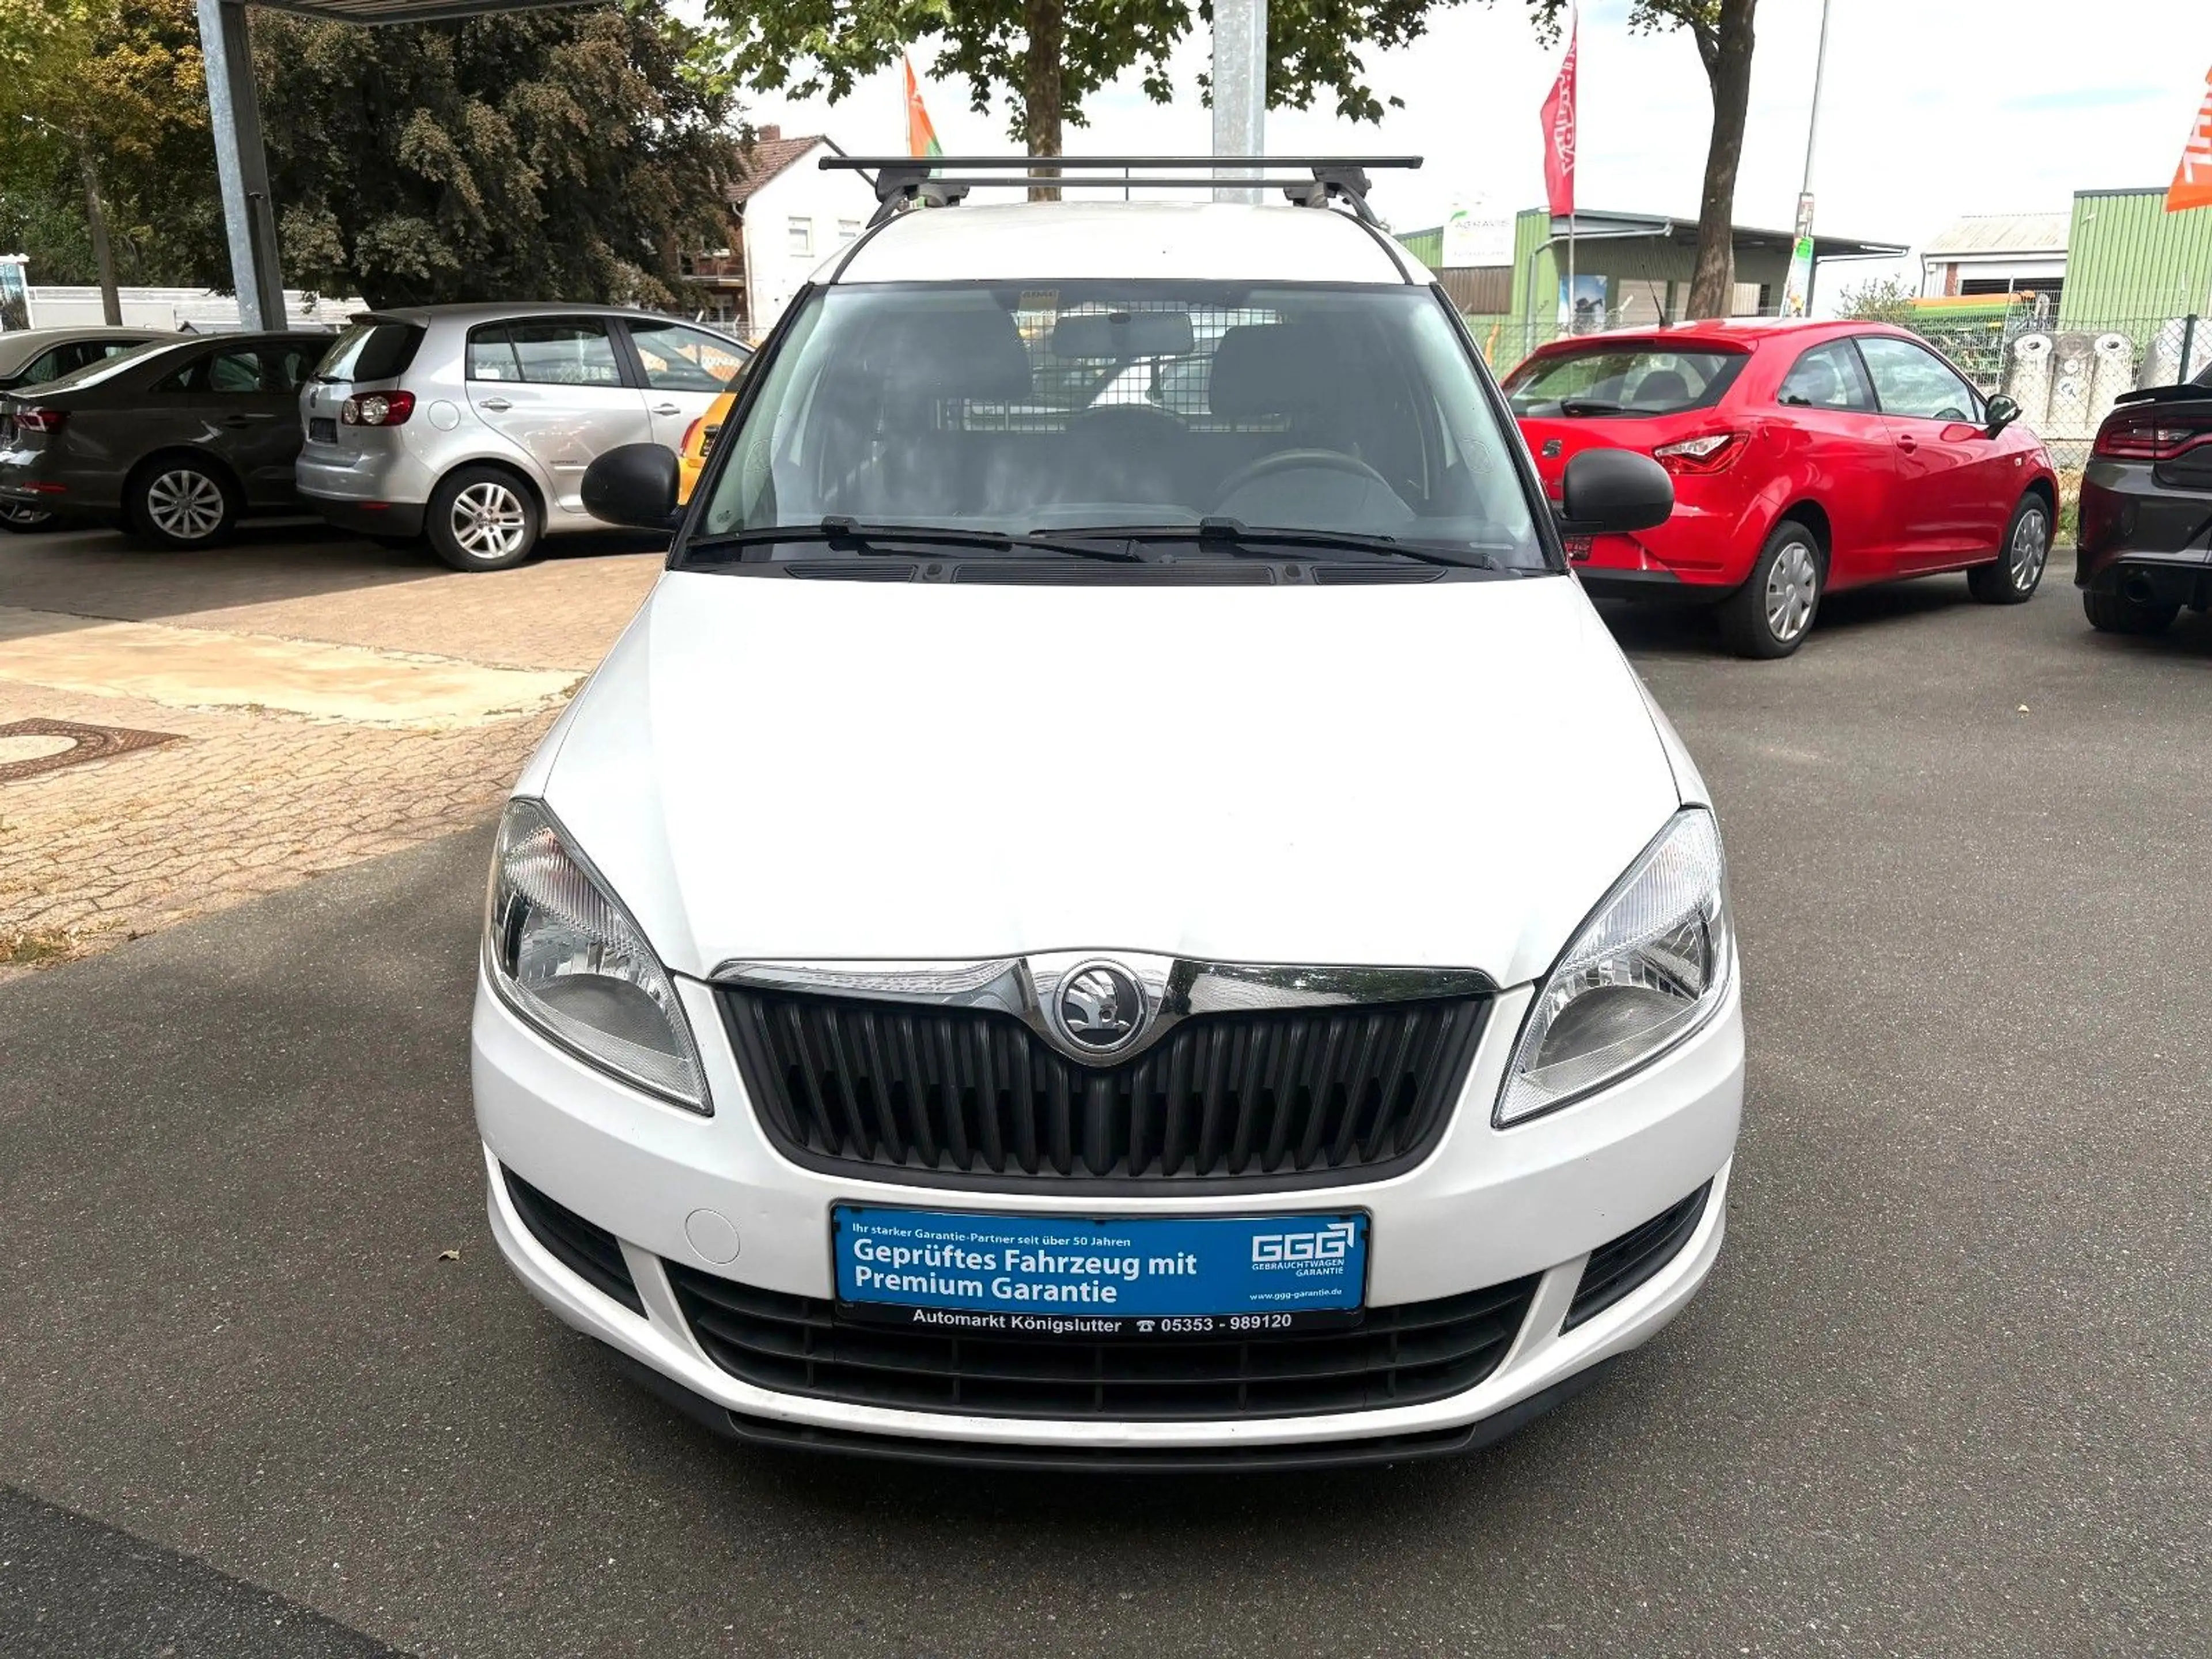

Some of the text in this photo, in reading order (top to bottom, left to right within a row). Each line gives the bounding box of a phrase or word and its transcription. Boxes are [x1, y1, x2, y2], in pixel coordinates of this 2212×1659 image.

[853, 1222, 1131, 1247] Ihr starker Garantie-Partner seit über 50 Jahren
[1252, 1229, 1347, 1262] GGG
[853, 1238, 1198, 1281] Geprüftes Fahrzeug mit
[1251, 1258, 1345, 1271] GEBRAUCHTWAGEN
[1295, 1266, 1344, 1278] GARANTIE
[855, 1265, 1118, 1303] Premium Garantie
[1249, 1288, 1342, 1301] www.ggg-garantie.de
[912, 1309, 1006, 1328] Automarkt
[1010, 1315, 1123, 1334] Königslutter
[1160, 1317, 1214, 1332] 05353
[1229, 1313, 1292, 1330] 989120
